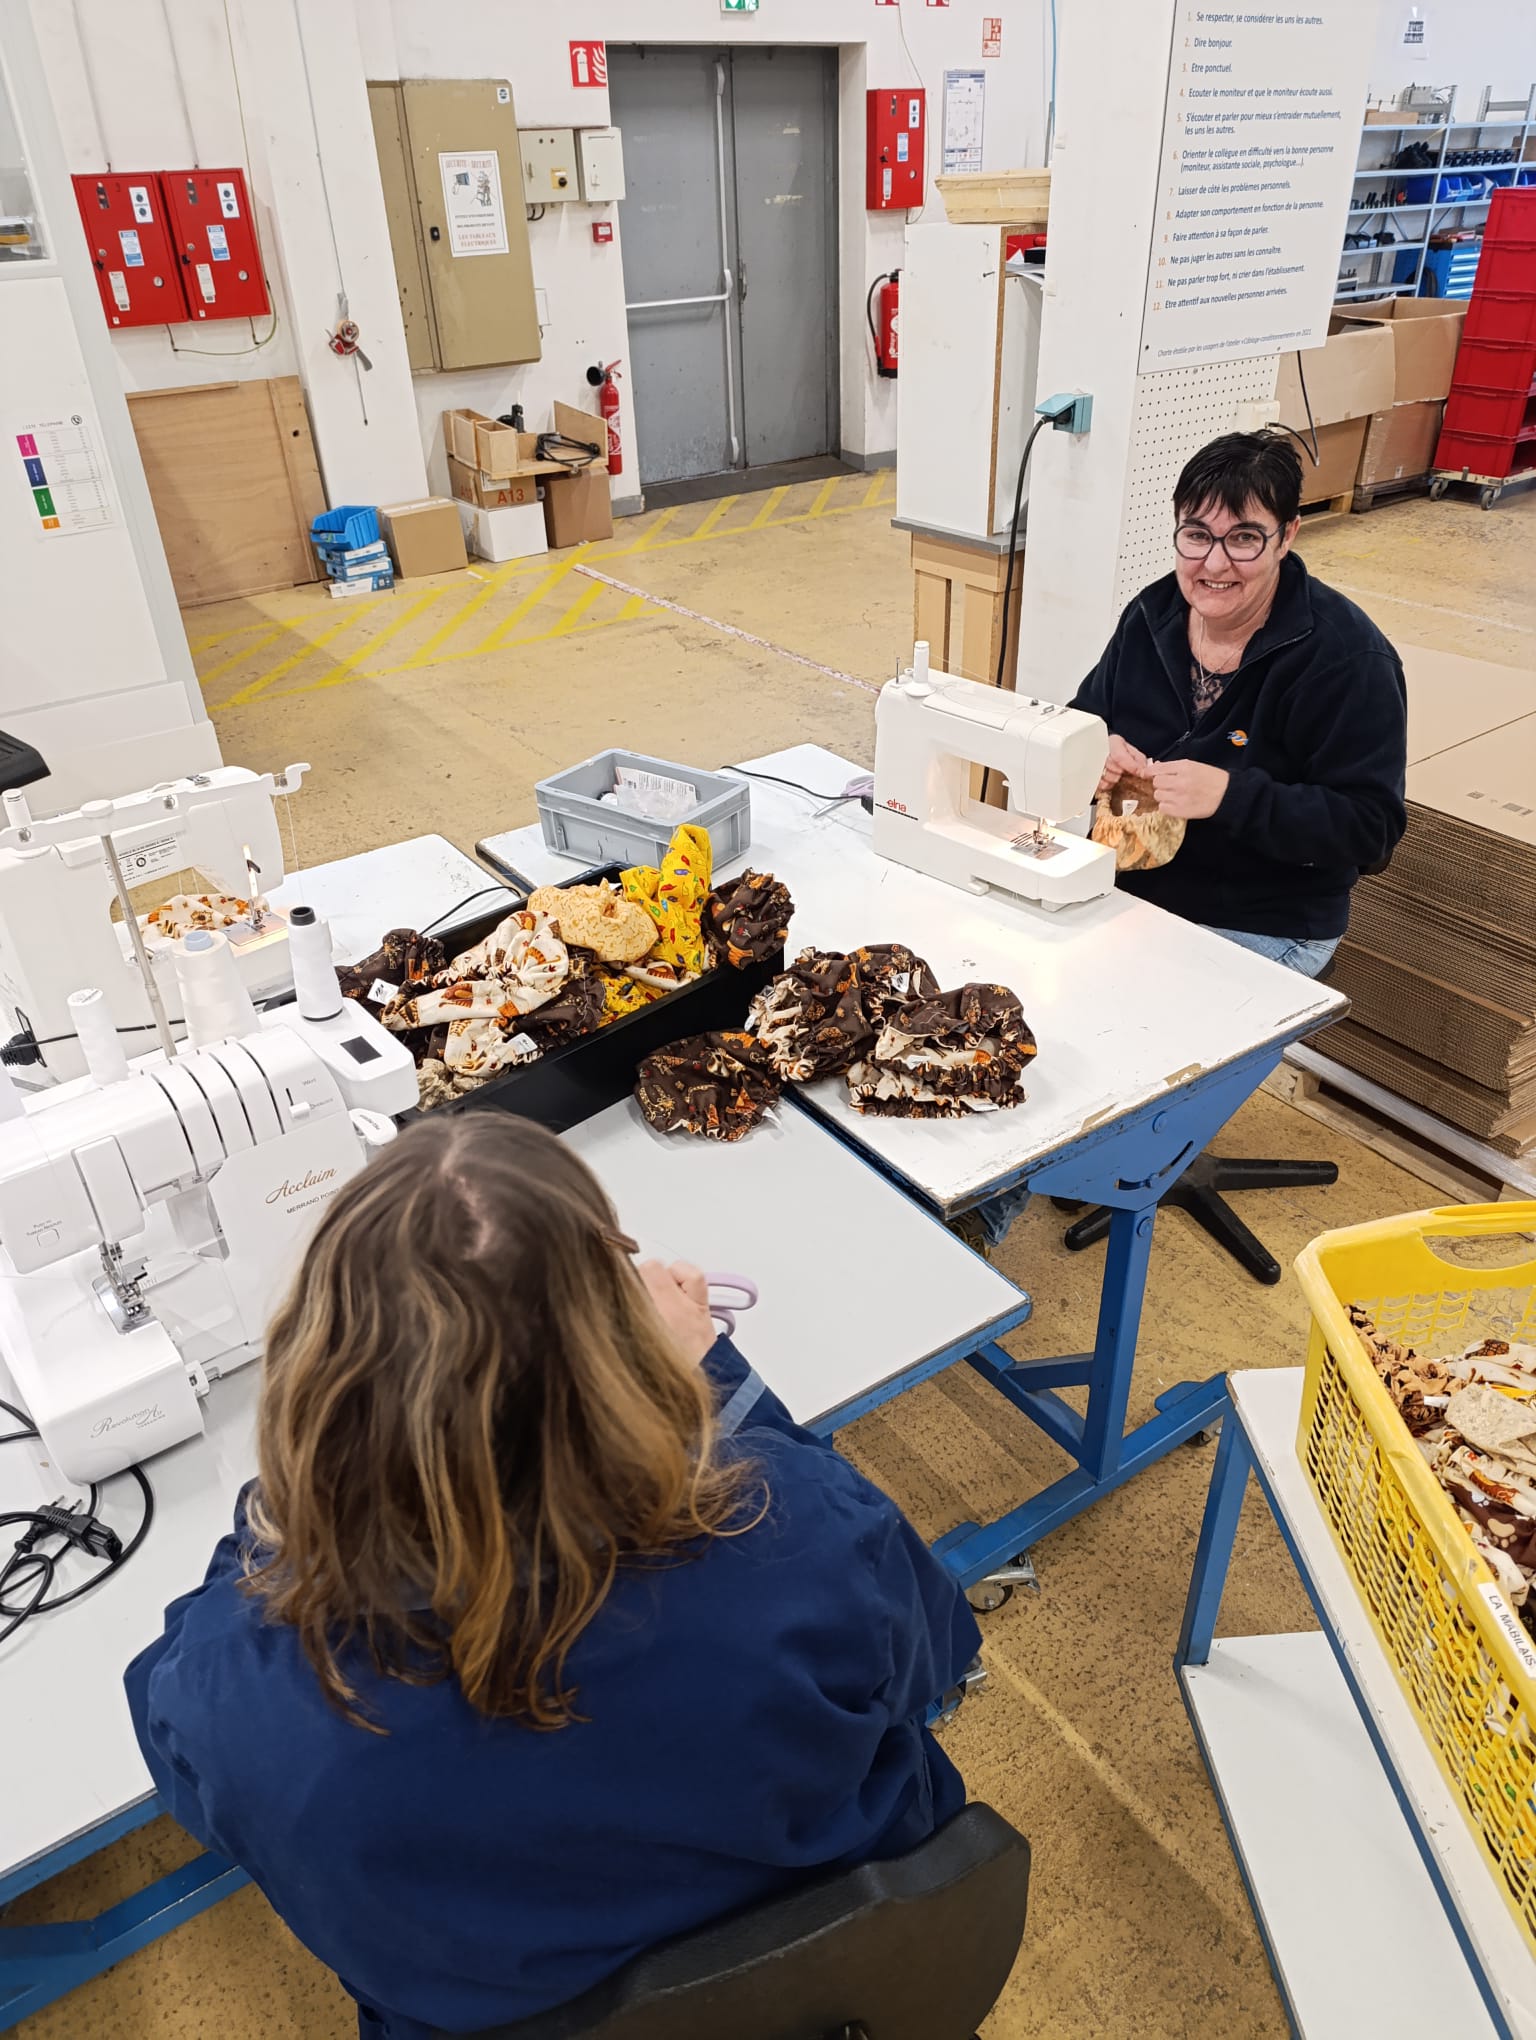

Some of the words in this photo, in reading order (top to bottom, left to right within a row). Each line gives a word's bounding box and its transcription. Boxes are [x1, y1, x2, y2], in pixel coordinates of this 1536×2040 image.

[1206, 13, 1234, 24] respecter,
[1244, 13, 1274, 24] considérer
[1284, 16, 1295, 24] uns
[1304, 16, 1324, 24] autres.
[1194, 37, 1206, 48] Dire
[1208, 37, 1232, 50] bonjour.
[1191, 63, 1204, 72] Etre
[1205, 63, 1232, 74] ponctuel.
[1188, 88, 1212, 98] Ecouter
[1220, 88, 1246, 97] moniteur
[1254, 90, 1266, 98] que
[1273, 88, 1298, 96] moniteur
[1300, 87, 1318, 96] écoute
[1318, 88, 1333, 96] aussi.
[1186, 112, 1214, 122] S'écouter
[1222, 112, 1240, 124] parler
[1240, 113, 1254, 122] pour
[1255, 112, 1272, 120] mieux
[1274, 110, 1302, 120] s'entraider
[1303, 110, 1342, 120] mutuellement,
[1184, 126, 1194, 135] les
[1216, 126, 1236, 134] autres.
[1182, 150, 1208, 159] Orienter
[1214, 148, 1238, 159] collègue
[1248, 146, 1272, 156] difficulté
[1292, 146, 1309, 154] bonne
[1310, 146, 1334, 155] personne
[1178, 186, 1198, 196] Laisser
[1208, 184, 1220, 194] côté
[1230, 182, 1260, 194] problèmes
[1260, 181, 1291, 192] personnels.
[1176, 210, 1200, 220] Adapter
[1212, 206, 1253, 217] comportement
[1262, 203, 1284, 213] fonction
[1298, 201, 1324, 212] personne.
[1172, 232, 1188, 242] Faire
[1188, 230, 1214, 240] attention
[1228, 228, 1242, 238] façon
[1252, 225, 1269, 236] parler.
[1170, 256, 1179, 265] Ne
[1180, 256, 1190, 266] pas
[1190, 253, 1206, 264] juger
[1216, 251, 1234, 260] autres
[1234, 250, 1246, 258] sans
[1256, 246, 1282, 256] connaître.
[1168, 278, 1176, 287] Ne
[1176, 278, 1188, 288] pas
[1188, 275, 1206, 287] parler
[1206, 274, 1218, 284] trop
[1219, 272, 1231, 281] fort,
[1238, 270, 1252, 279] crier
[1252, 269, 1265, 278] dans
[1265, 264, 1305, 276] l'établissement.
[1165, 300, 1178, 310] Etre
[1178, 296, 1200, 308] attentif
[1200, 297, 1210, 305] aux
[1210, 292, 1238, 303] nouvelles
[1238, 290, 1266, 302] personnes
[1266, 288, 1288, 298] arrivées.
[498, 488, 524, 504] A13
[886, 798, 906, 812] elna
[265, 1168, 338, 1204] Acclaim
[1488, 1594, 1503, 1610] LA
[1500, 1614, 1536, 1666] MABILAIS
